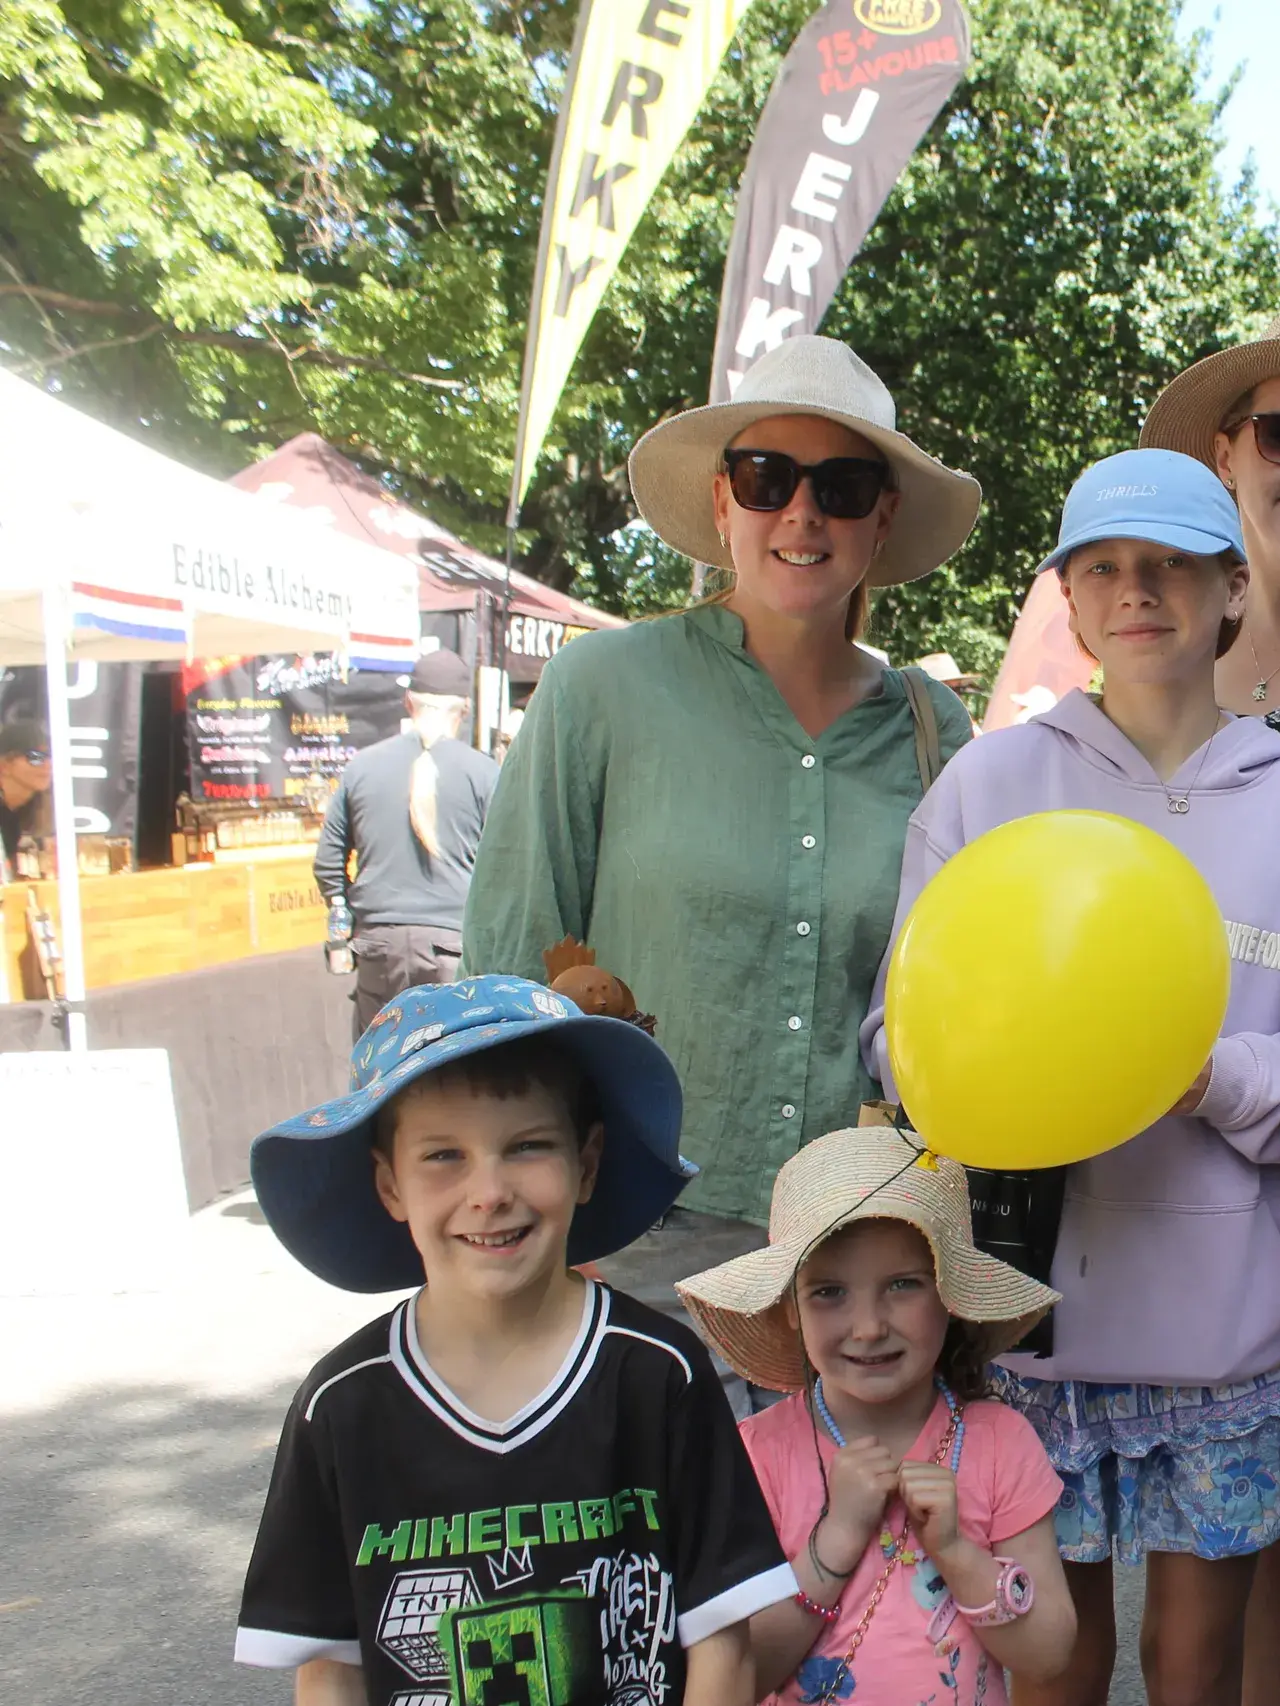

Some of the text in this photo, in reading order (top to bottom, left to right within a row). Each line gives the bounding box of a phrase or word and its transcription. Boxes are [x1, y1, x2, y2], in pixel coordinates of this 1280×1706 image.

[817, 28, 878, 70] 15+
[817, 35, 958, 97] FLAVOURS
[553, 0, 691, 318] ERKY
[1096, 485, 1158, 502] THRILLS
[172, 543, 255, 599] Edible
[504, 615, 565, 659] ERKY
[355, 1488, 661, 1567] MINECRAFT
[399, 1594, 458, 1614] TNT
